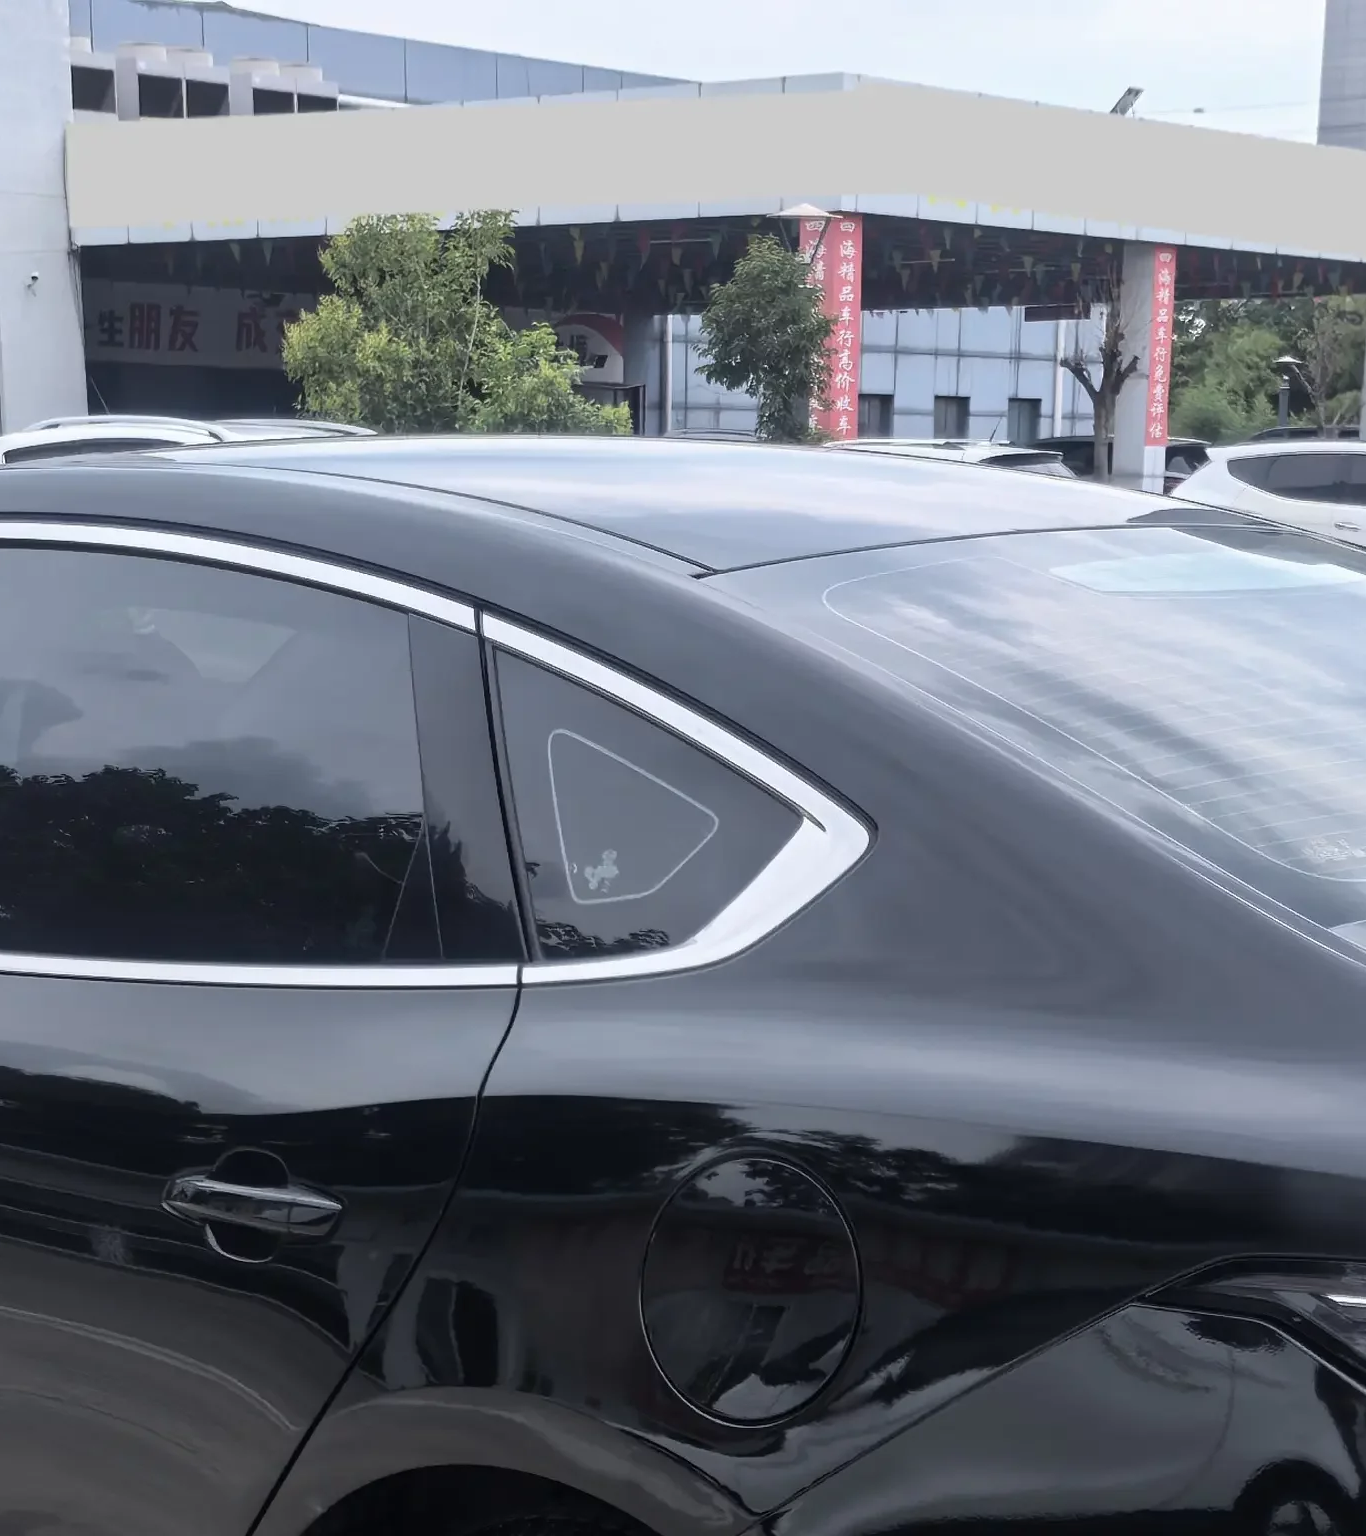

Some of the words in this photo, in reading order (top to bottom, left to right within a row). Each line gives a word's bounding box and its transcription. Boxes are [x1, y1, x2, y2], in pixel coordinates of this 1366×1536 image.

[836, 221, 857, 436] 四海精品车行高价收车
